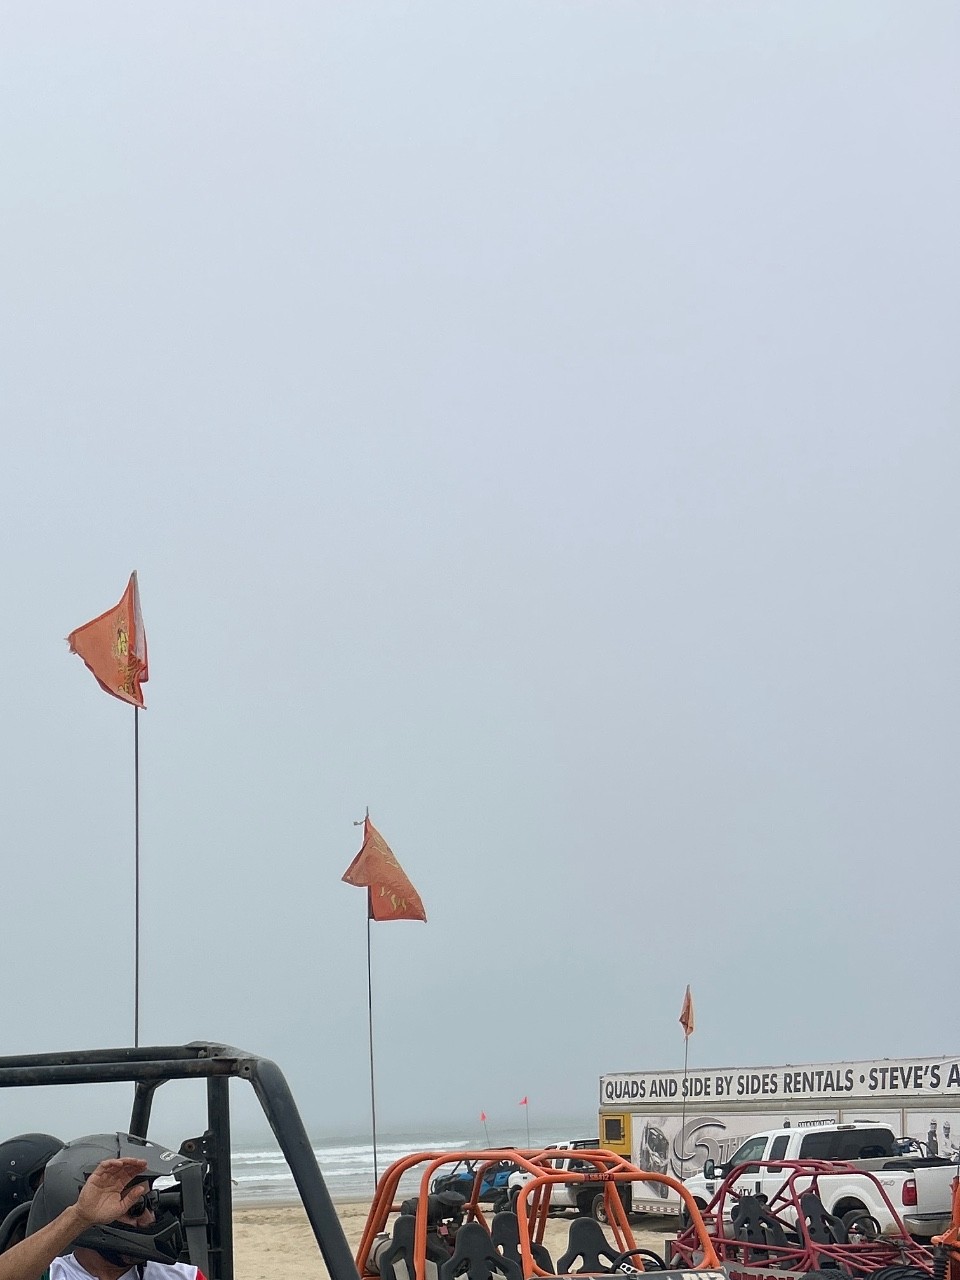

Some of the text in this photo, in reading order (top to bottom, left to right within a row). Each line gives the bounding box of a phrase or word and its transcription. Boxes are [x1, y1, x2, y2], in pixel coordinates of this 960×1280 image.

[605, 1079, 646, 1100] QUADS
[649, 1078, 678, 1098] AND
[681, 1077, 711, 1097] SIDE
[715, 1075, 734, 1096] BY
[737, 1073, 778, 1096] SIDES
[783, 1069, 854, 1094] RENTALS
[868, 1064, 941, 1091] STEVE'S
